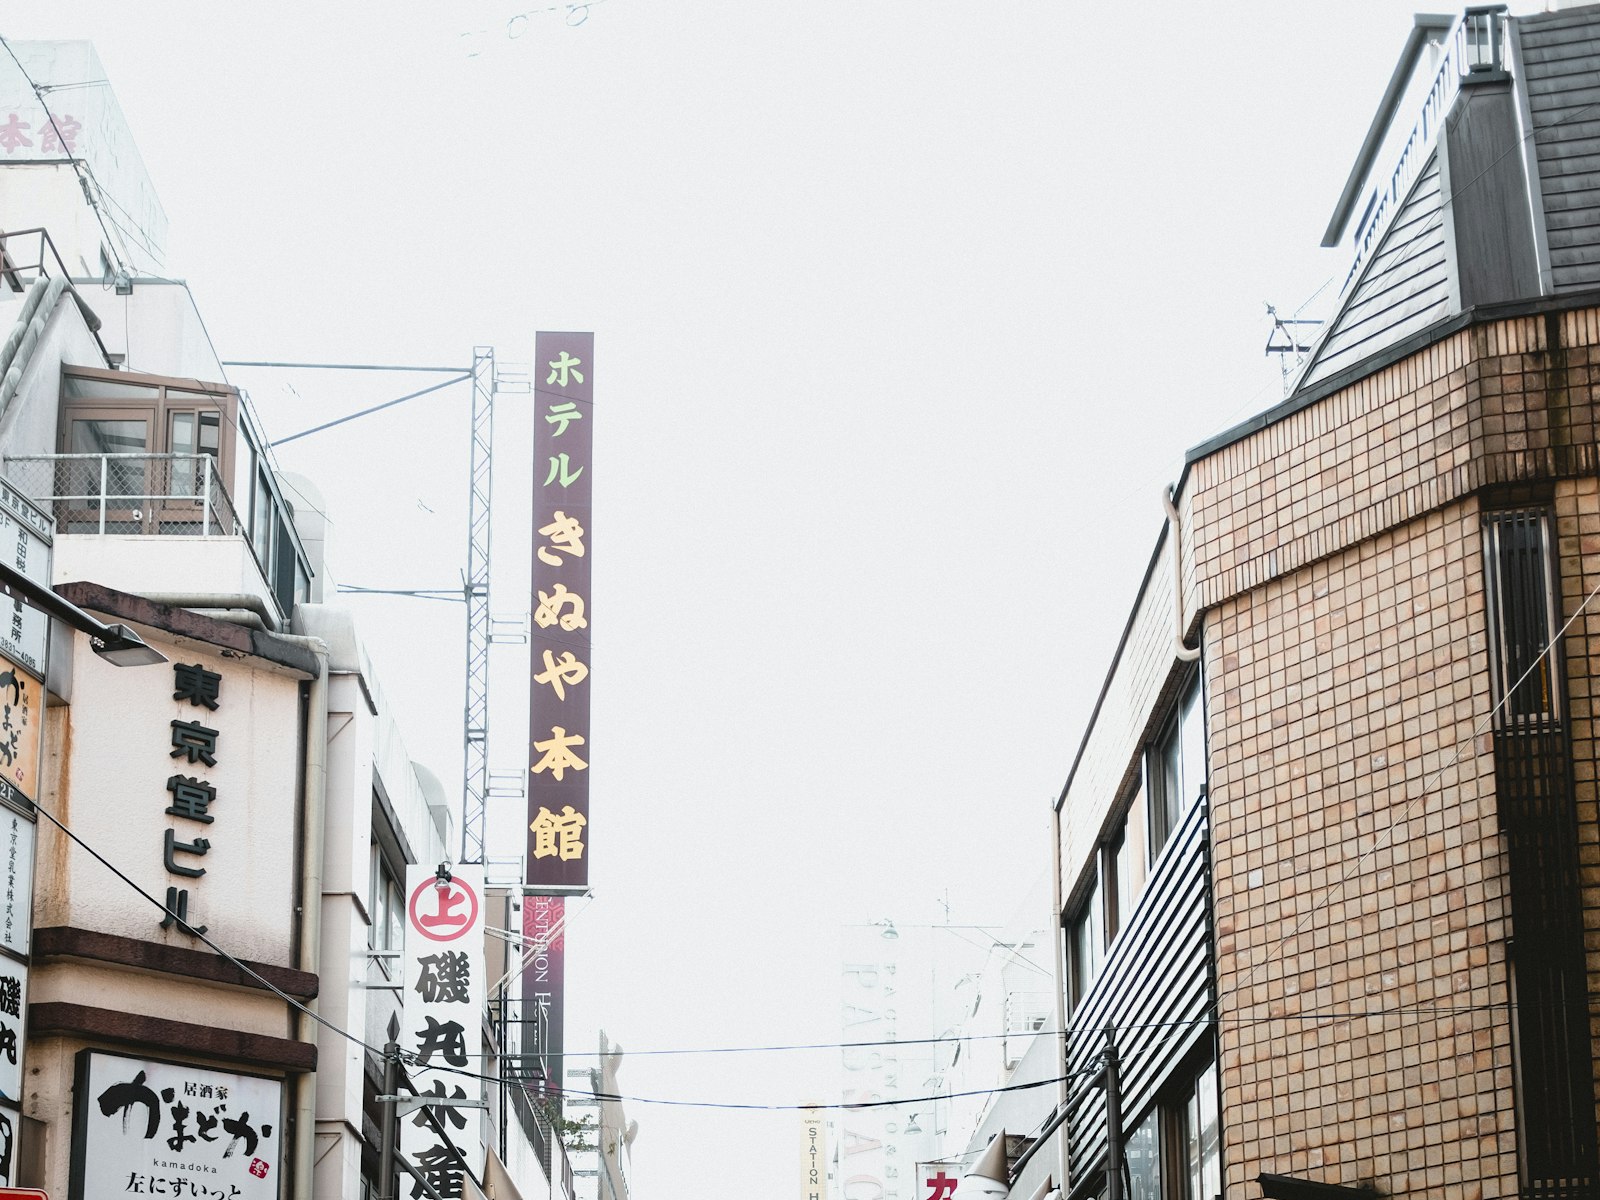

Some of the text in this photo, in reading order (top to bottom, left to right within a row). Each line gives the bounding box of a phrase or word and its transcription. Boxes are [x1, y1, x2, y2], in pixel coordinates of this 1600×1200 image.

[0, 113, 82, 155] 本館
[1, 486, 47, 533] 東京堂ビル
[0, 782, 15, 801] 2F
[160, 663, 223, 938] 東京堂ビル
[183, 1081, 229, 1101] 居酒家
[97, 1069, 274, 1160] かまどか
[152, 1157, 218, 1175] kamadoka
[808, 1126, 818, 1185] STATION
